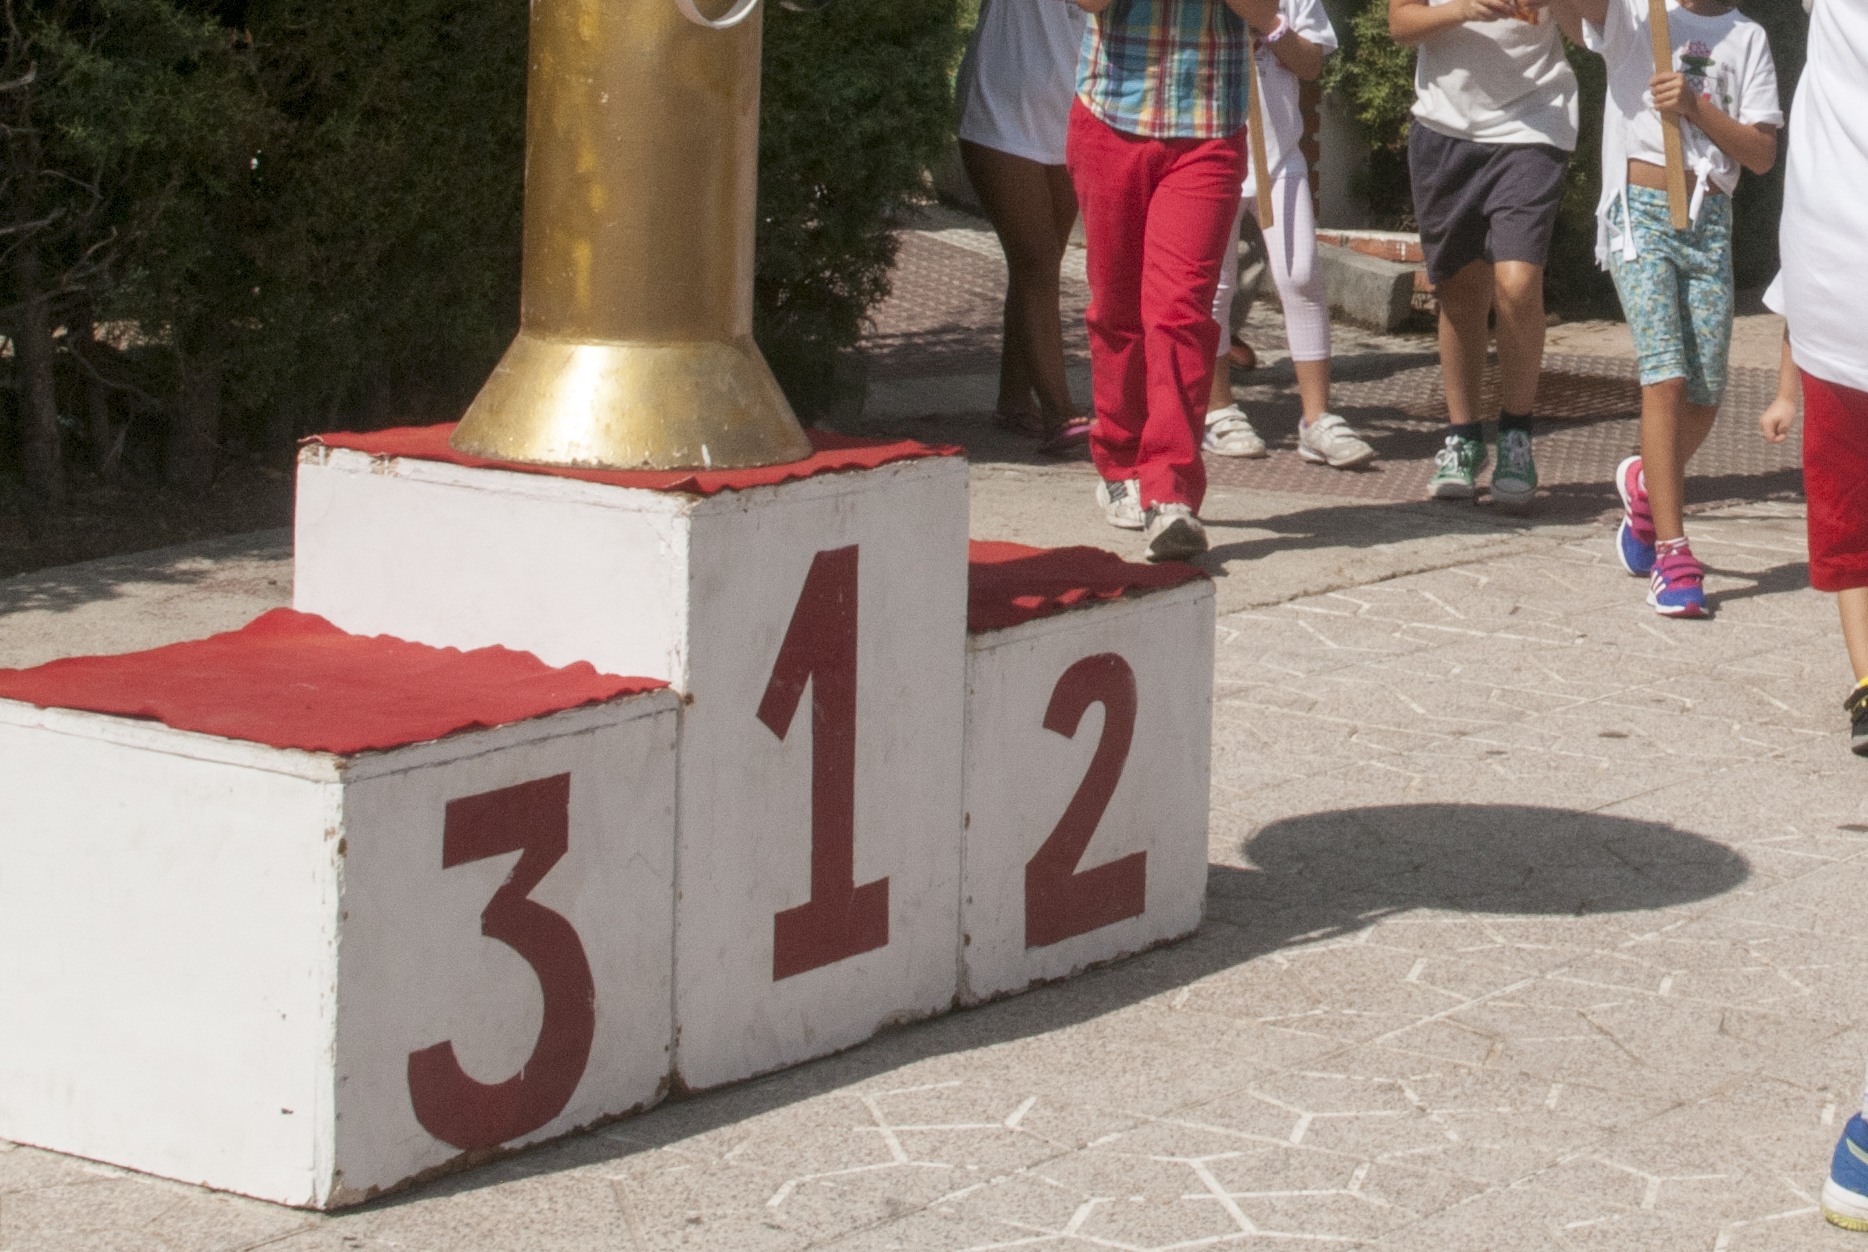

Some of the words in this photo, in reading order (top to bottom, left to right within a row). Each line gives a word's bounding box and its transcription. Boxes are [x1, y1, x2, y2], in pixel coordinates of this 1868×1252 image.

[756, 544, 891, 983] 1
[1023, 650, 1148, 950] 2
[406, 771, 596, 1149] 3
